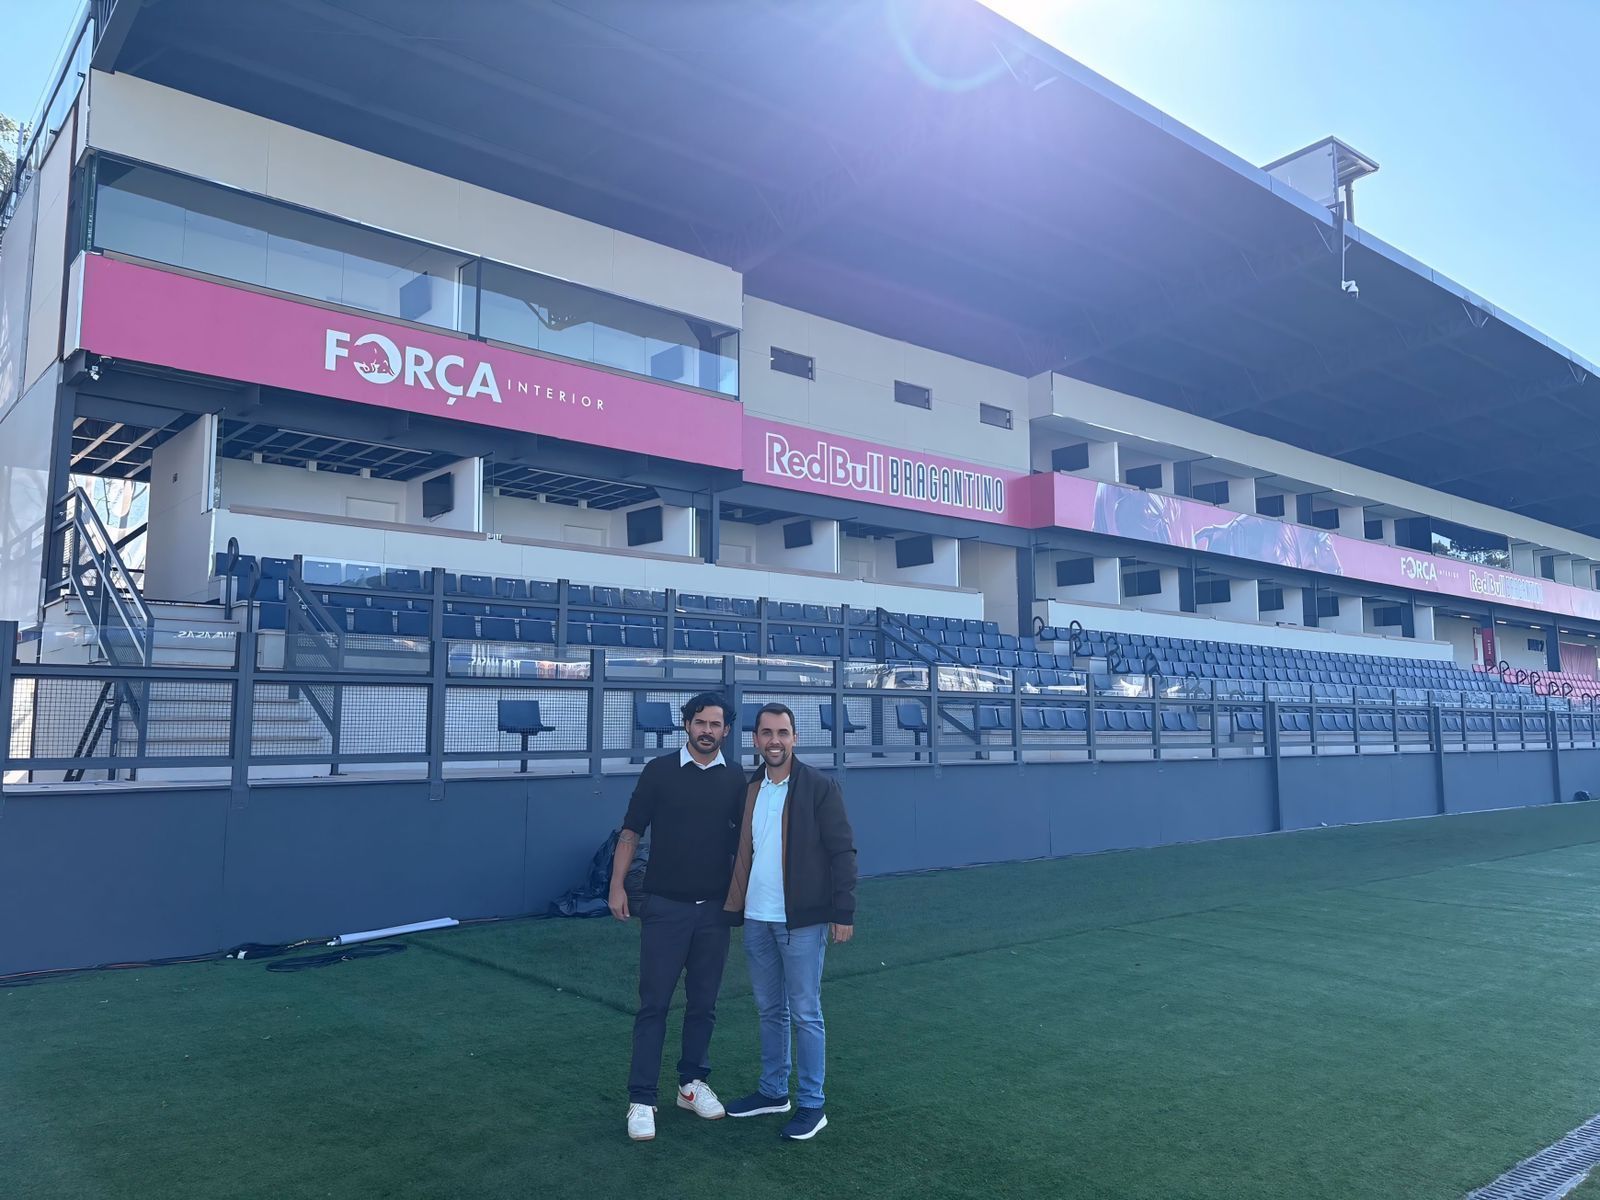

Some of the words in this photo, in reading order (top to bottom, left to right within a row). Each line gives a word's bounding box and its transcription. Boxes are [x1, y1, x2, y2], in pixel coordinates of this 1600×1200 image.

[325, 329, 502, 406] FORÇA
[508, 379, 604, 410] INTERIOR
[765, 432, 827, 483] Red
[830, 446, 884, 493] Bull
[889, 456, 1004, 514] BRAGANTINO
[1400, 556, 1438, 584] FORÇA
